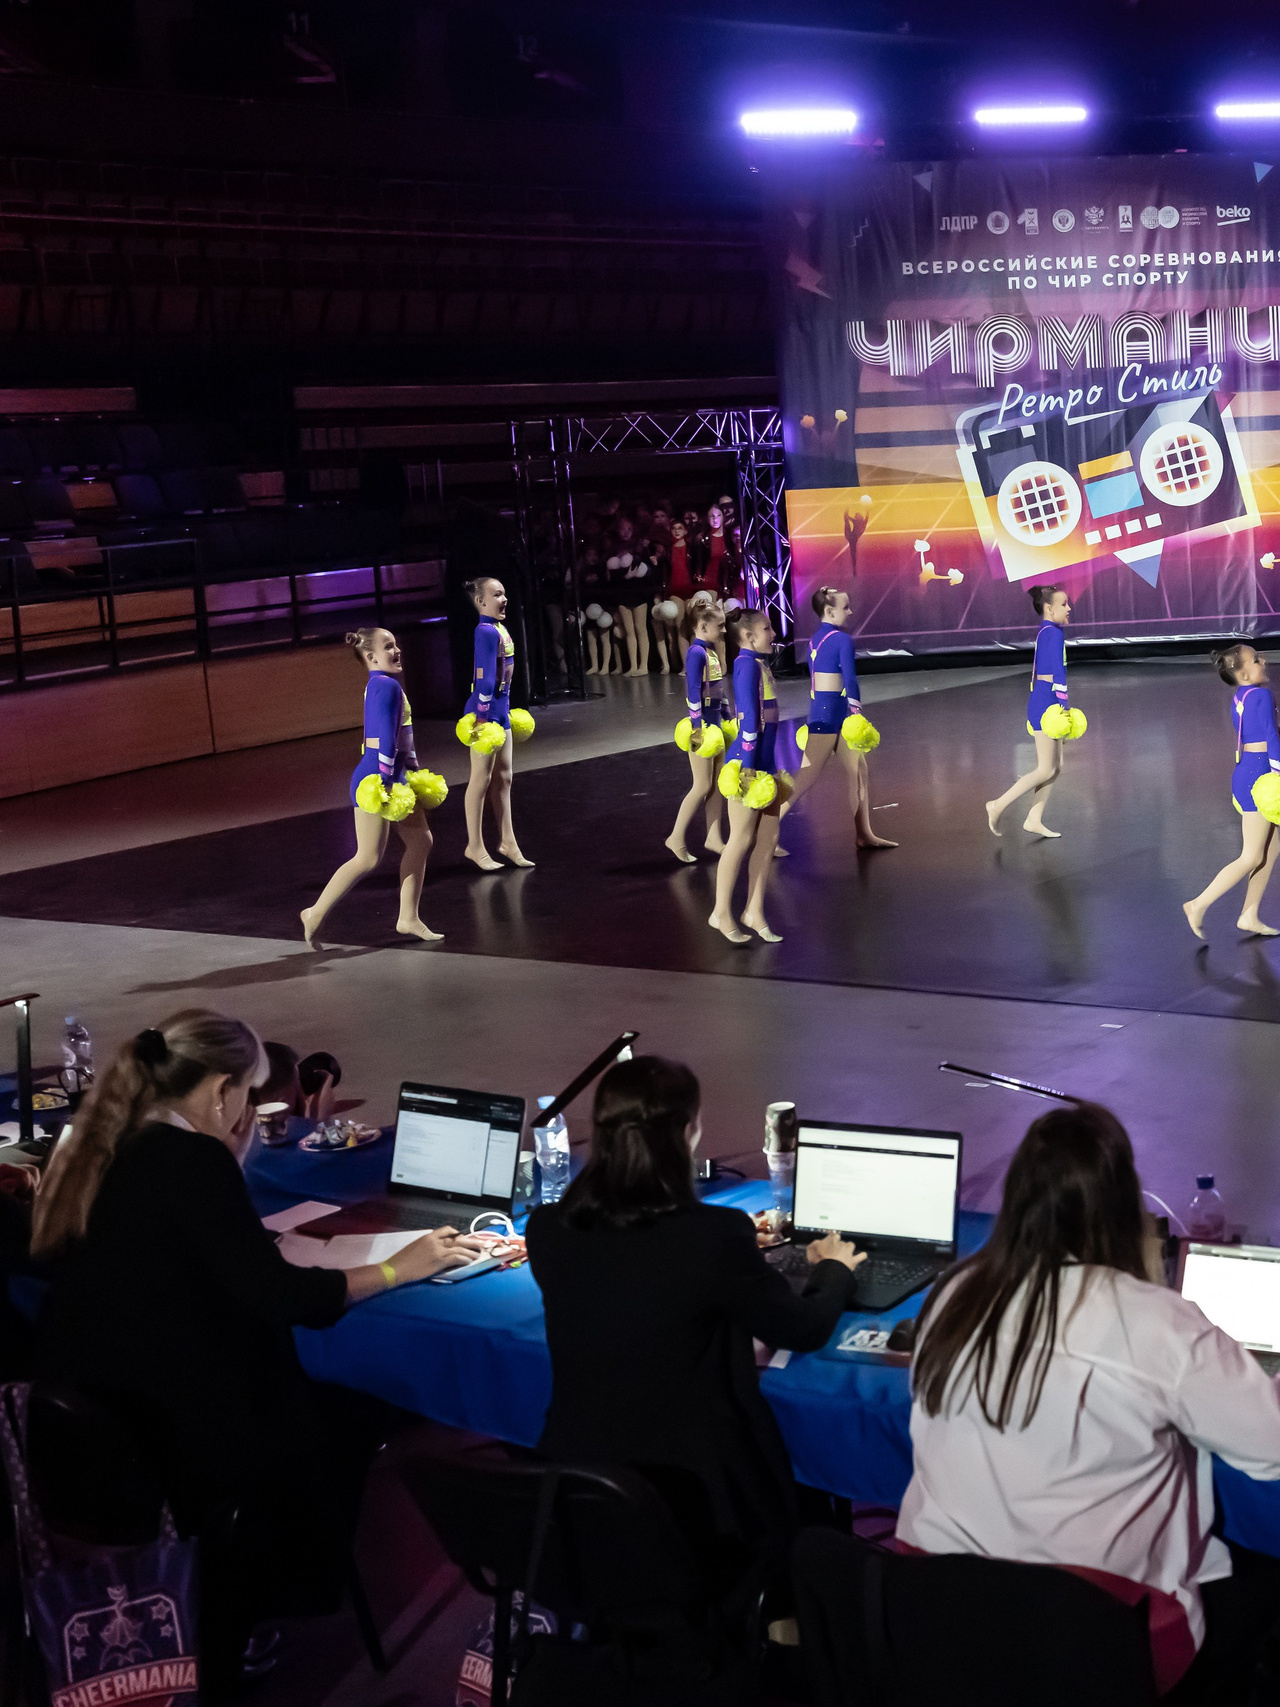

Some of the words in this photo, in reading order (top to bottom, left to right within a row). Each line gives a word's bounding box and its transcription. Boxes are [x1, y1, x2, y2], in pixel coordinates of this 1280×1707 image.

[287, 11, 310, 35] 11
[1217, 205, 1251, 218] beko
[940, 215, 978, 232] ЛДПР
[902, 254, 1099, 276] ВСЕРОССИЙСКИЕ
[1008, 275, 1038, 290] ПО
[1048, 273, 1092, 289] ЧИР
[1102, 270, 1189, 287] СПОРТУ
[998, 383, 1103, 426] Ретро
[1118, 362, 1223, 403] Стиль
